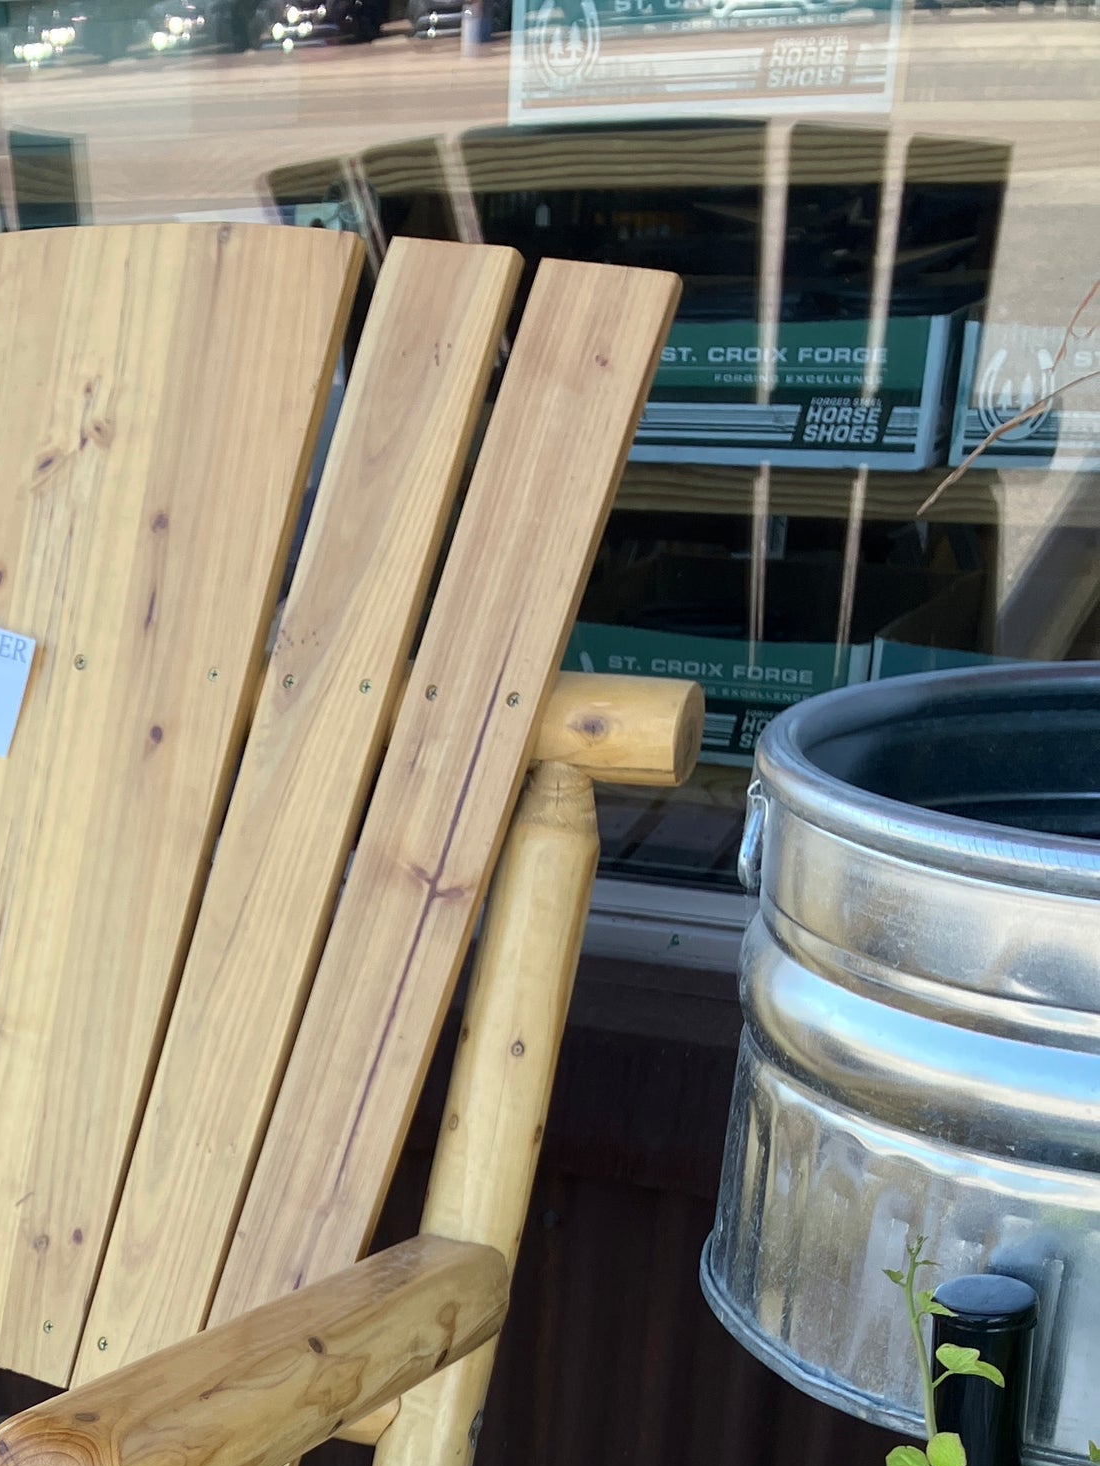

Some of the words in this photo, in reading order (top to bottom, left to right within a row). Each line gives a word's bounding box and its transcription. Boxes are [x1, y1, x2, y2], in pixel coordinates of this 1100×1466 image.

[769, 45, 848, 67] HORSE
[766, 66, 846, 89] SHOES
[660, 346, 698, 363] ST.
[707, 346, 788, 363] CROIX
[798, 347, 888, 364] FORGE
[714, 372, 780, 385] FORGING
[785, 372, 884, 386] EXCELLENCE
[805, 405, 881, 425] HORSE
[802, 423, 879, 444] SHOES
[608, 654, 642, 672] ST.
[651, 658, 724, 678] CROIX
[732, 664, 813, 685] FORGE
